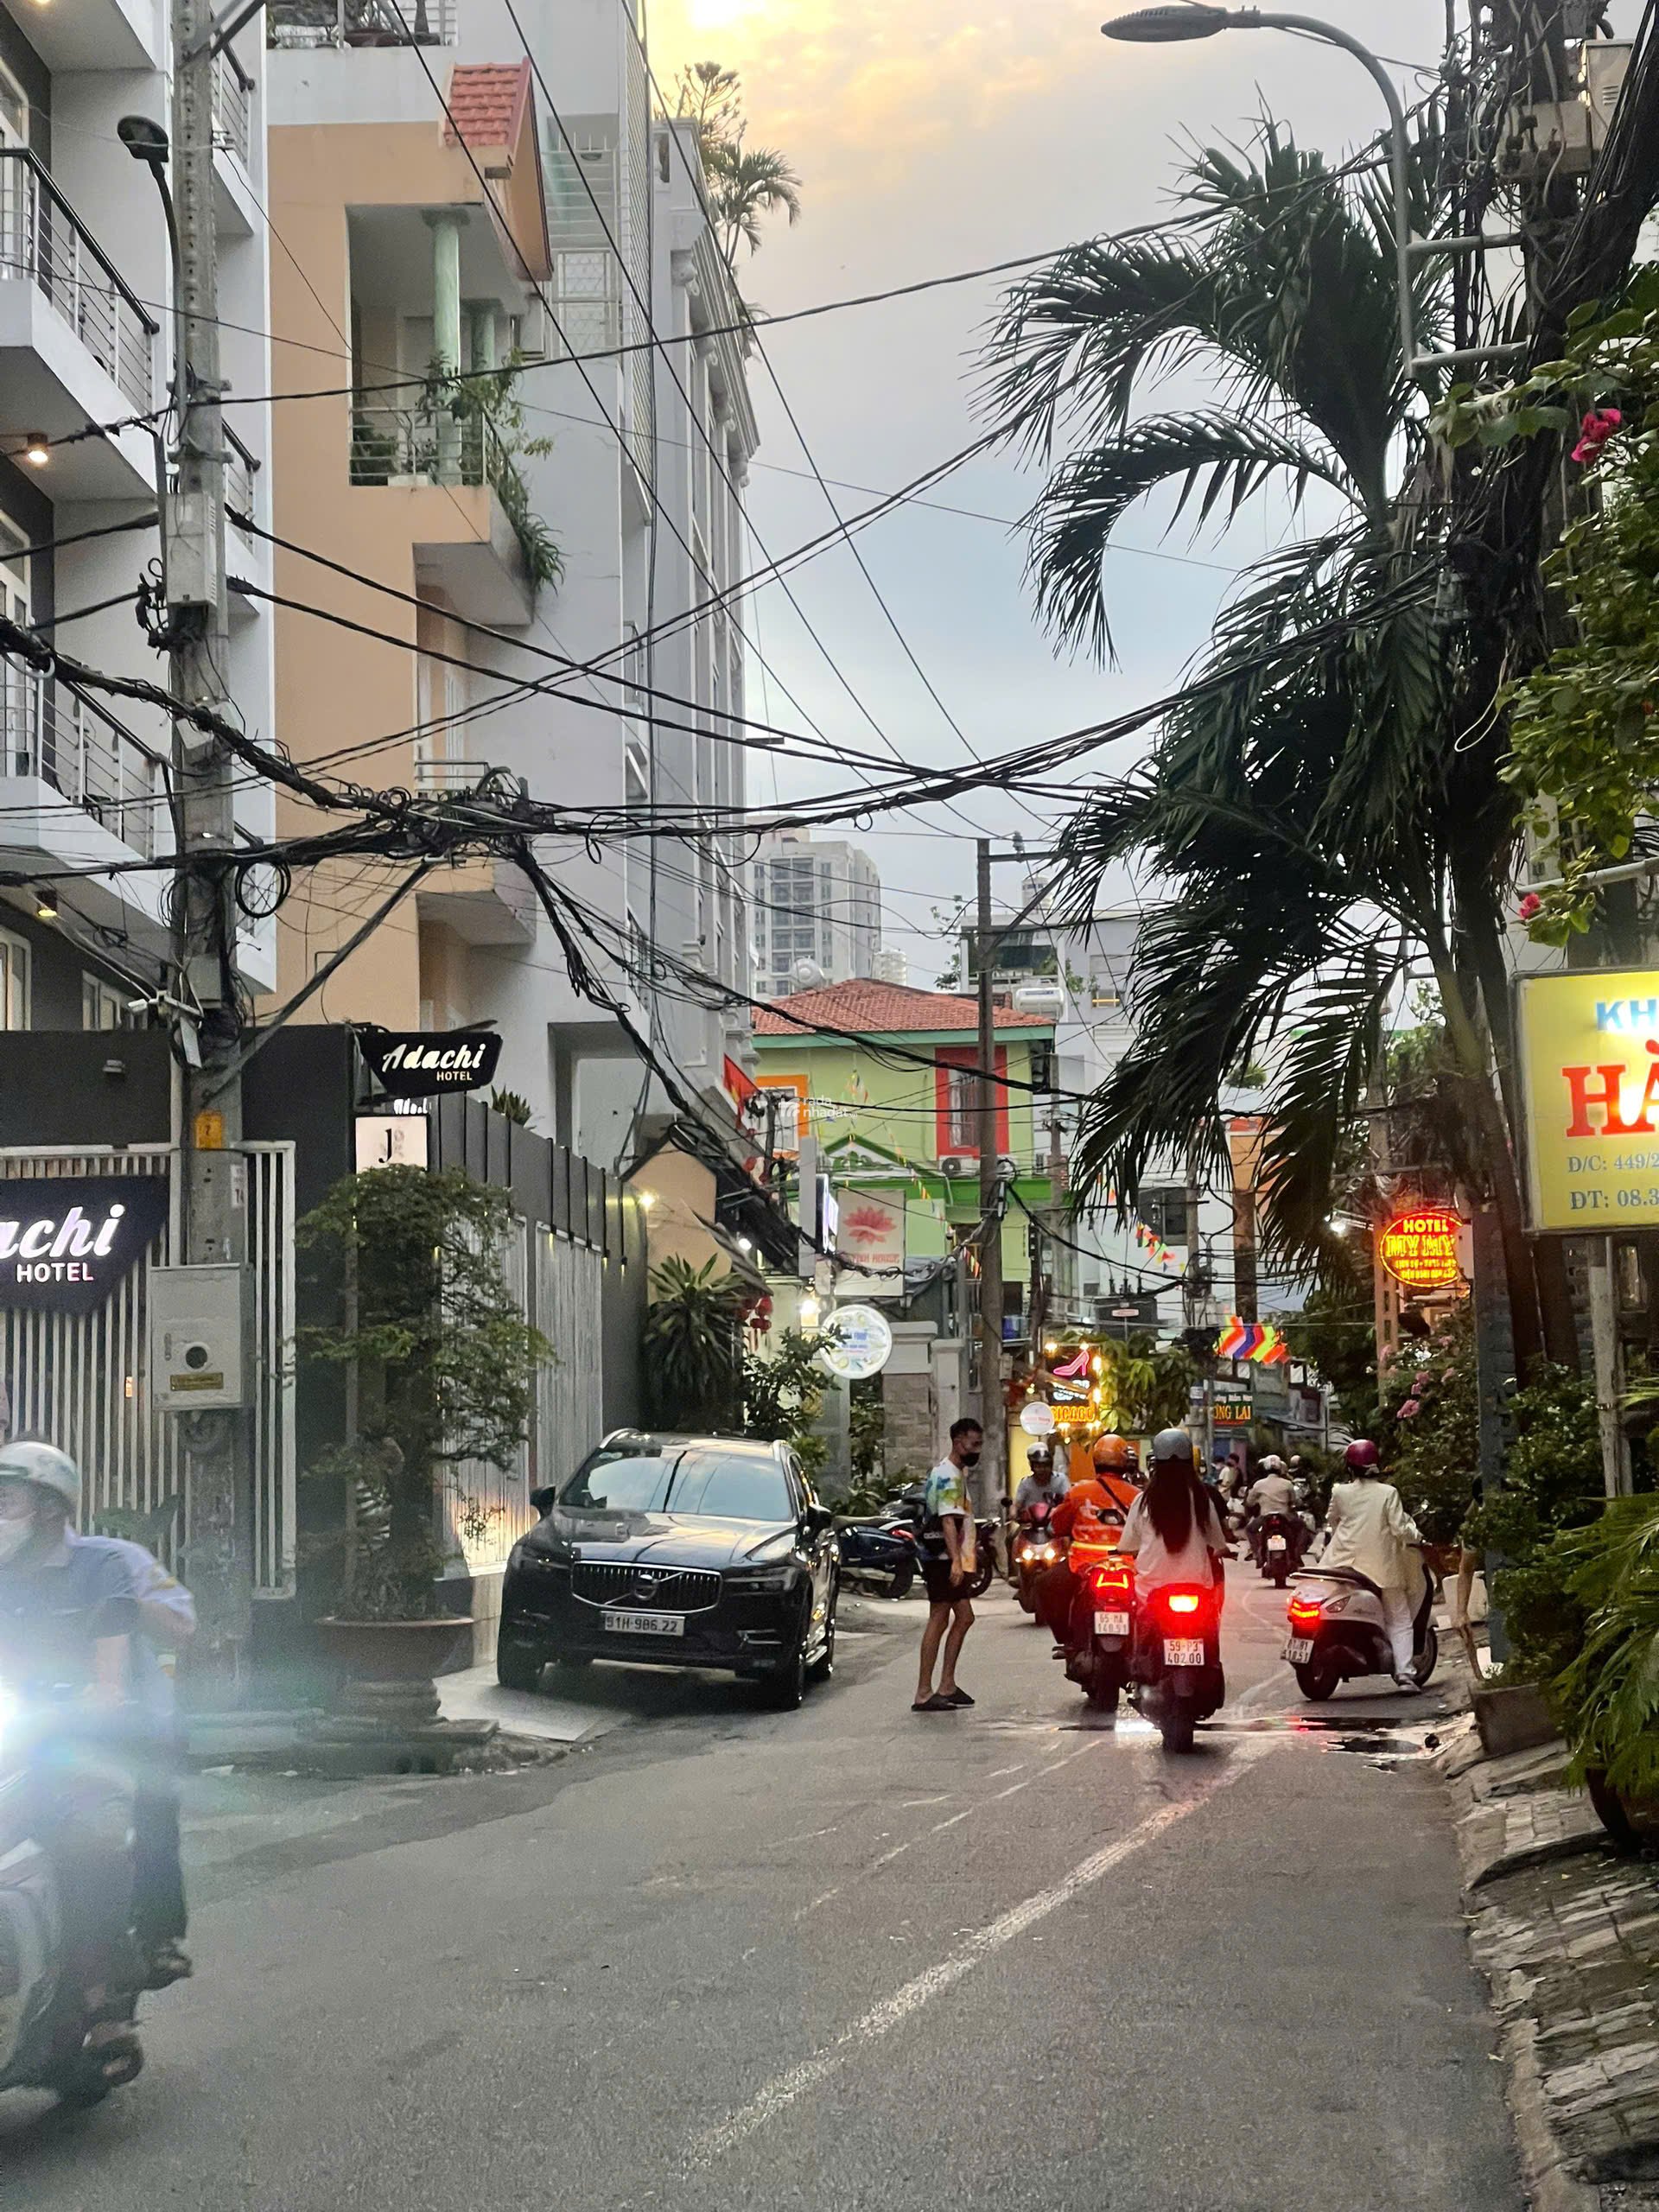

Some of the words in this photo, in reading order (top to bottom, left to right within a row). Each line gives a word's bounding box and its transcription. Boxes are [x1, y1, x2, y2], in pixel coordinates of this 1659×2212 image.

[381, 1043, 486, 1073] Adachi
[436, 1071, 473, 1082] HOTEL
[1402, 1218, 1449, 1233] HOTEL
[16, 1262, 94, 1283] HOTEL
[1235, 1405, 1251, 1420] LAI
